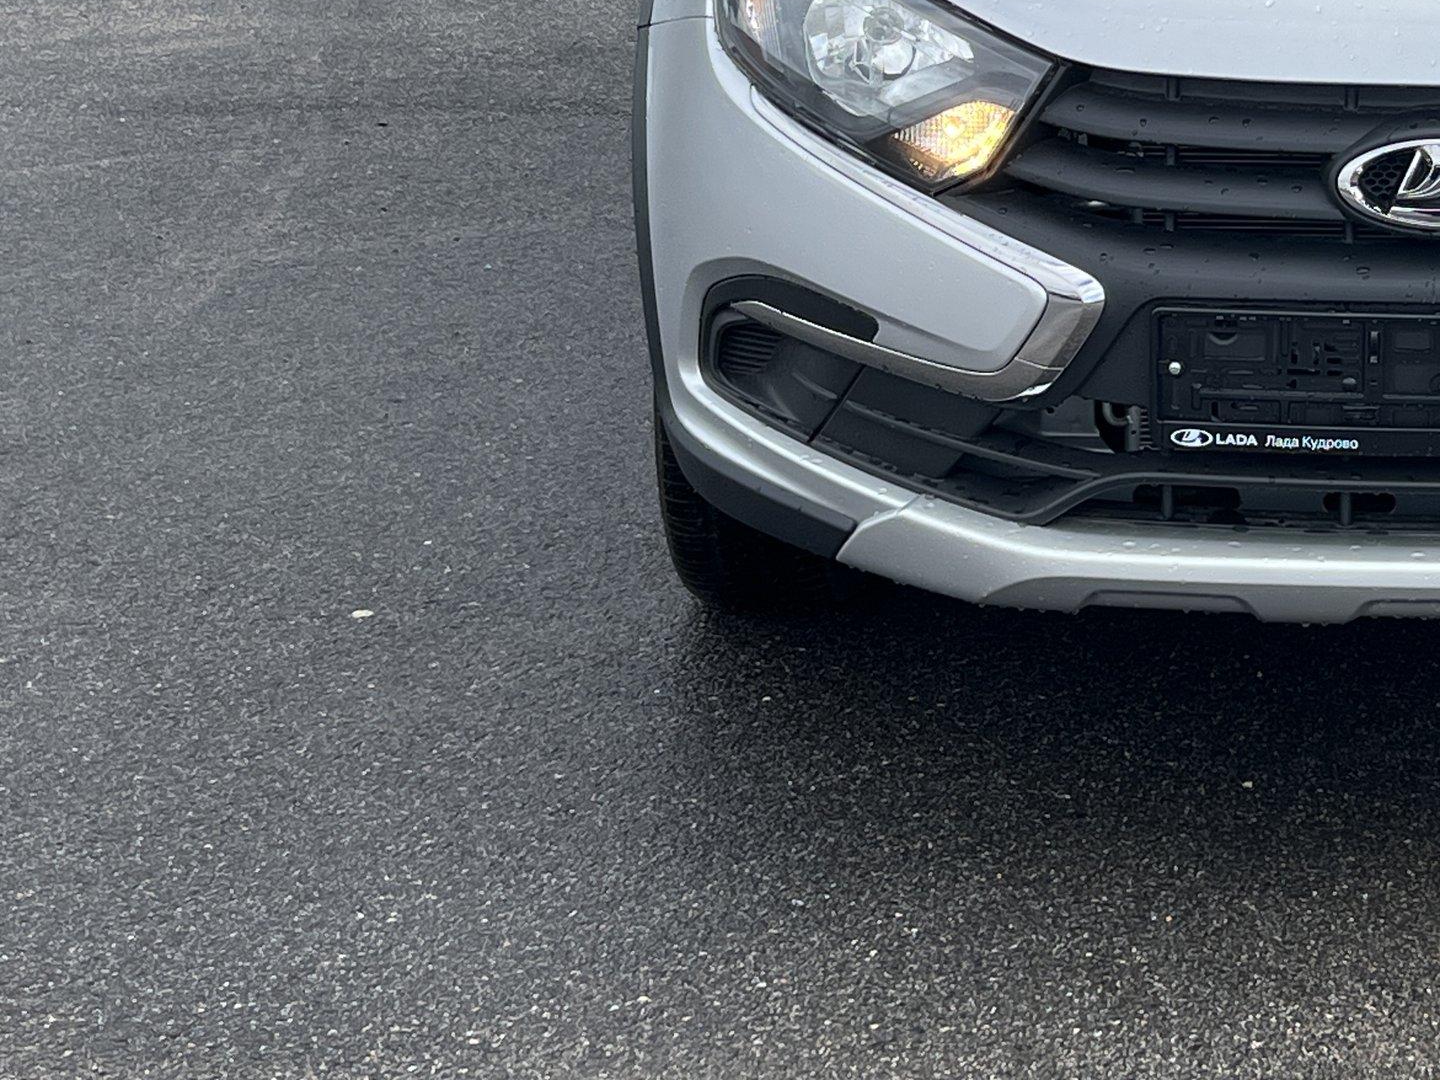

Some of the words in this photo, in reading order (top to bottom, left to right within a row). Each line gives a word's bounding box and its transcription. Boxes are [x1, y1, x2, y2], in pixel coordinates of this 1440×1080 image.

[1216, 433, 1258, 447] LADA
[1265, 435, 1300, 449] Лада
[1302, 436, 1359, 451] Кудрово
